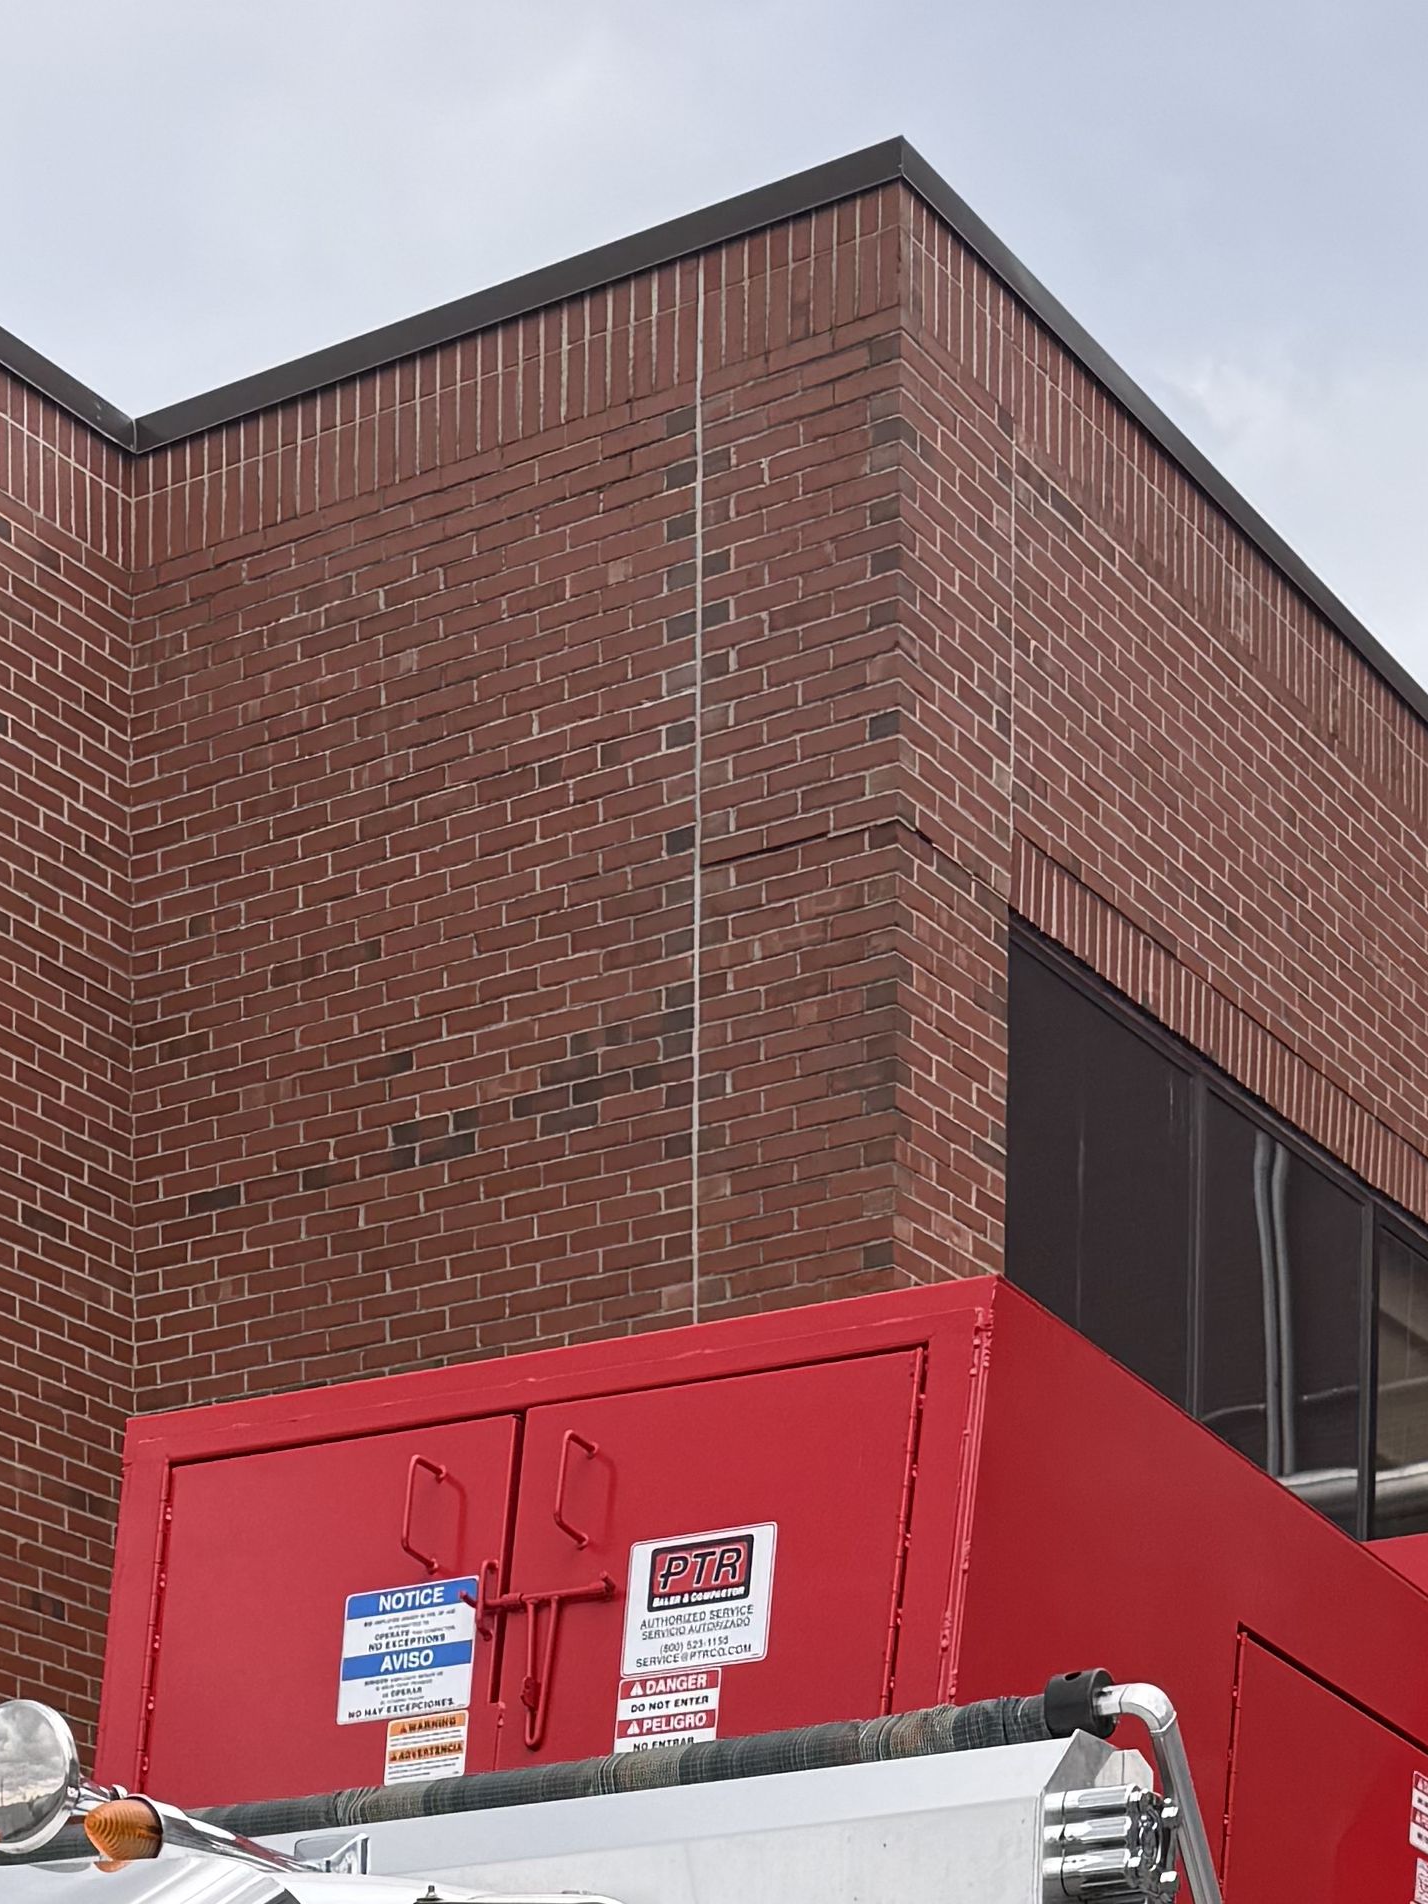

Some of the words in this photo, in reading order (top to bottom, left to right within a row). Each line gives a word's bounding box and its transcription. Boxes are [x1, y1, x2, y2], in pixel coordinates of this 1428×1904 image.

[659, 1545, 743, 1592] PTR
[378, 1586, 445, 1612] NOTICE
[640, 1611, 706, 1630] AUTHORIZED
[709, 1604, 754, 1620] SERVICE
[385, 1633, 446, 1649] EXCEPTIONS
[642, 1625, 686, 1640] SERVICIO
[380, 1650, 434, 1672] AVISO
[646, 1673, 707, 1694] DANGER
[631, 1703, 645, 1713] DO
[649, 1700, 670, 1711] NOT
[674, 1695, 709, 1707] ENTER
[408, 1716, 457, 1732] WARNING
[642, 1712, 707, 1733] PELIGRO
[397, 1742, 463, 1760] ADVERTENCIA
[633, 1742, 648, 1752] NO
